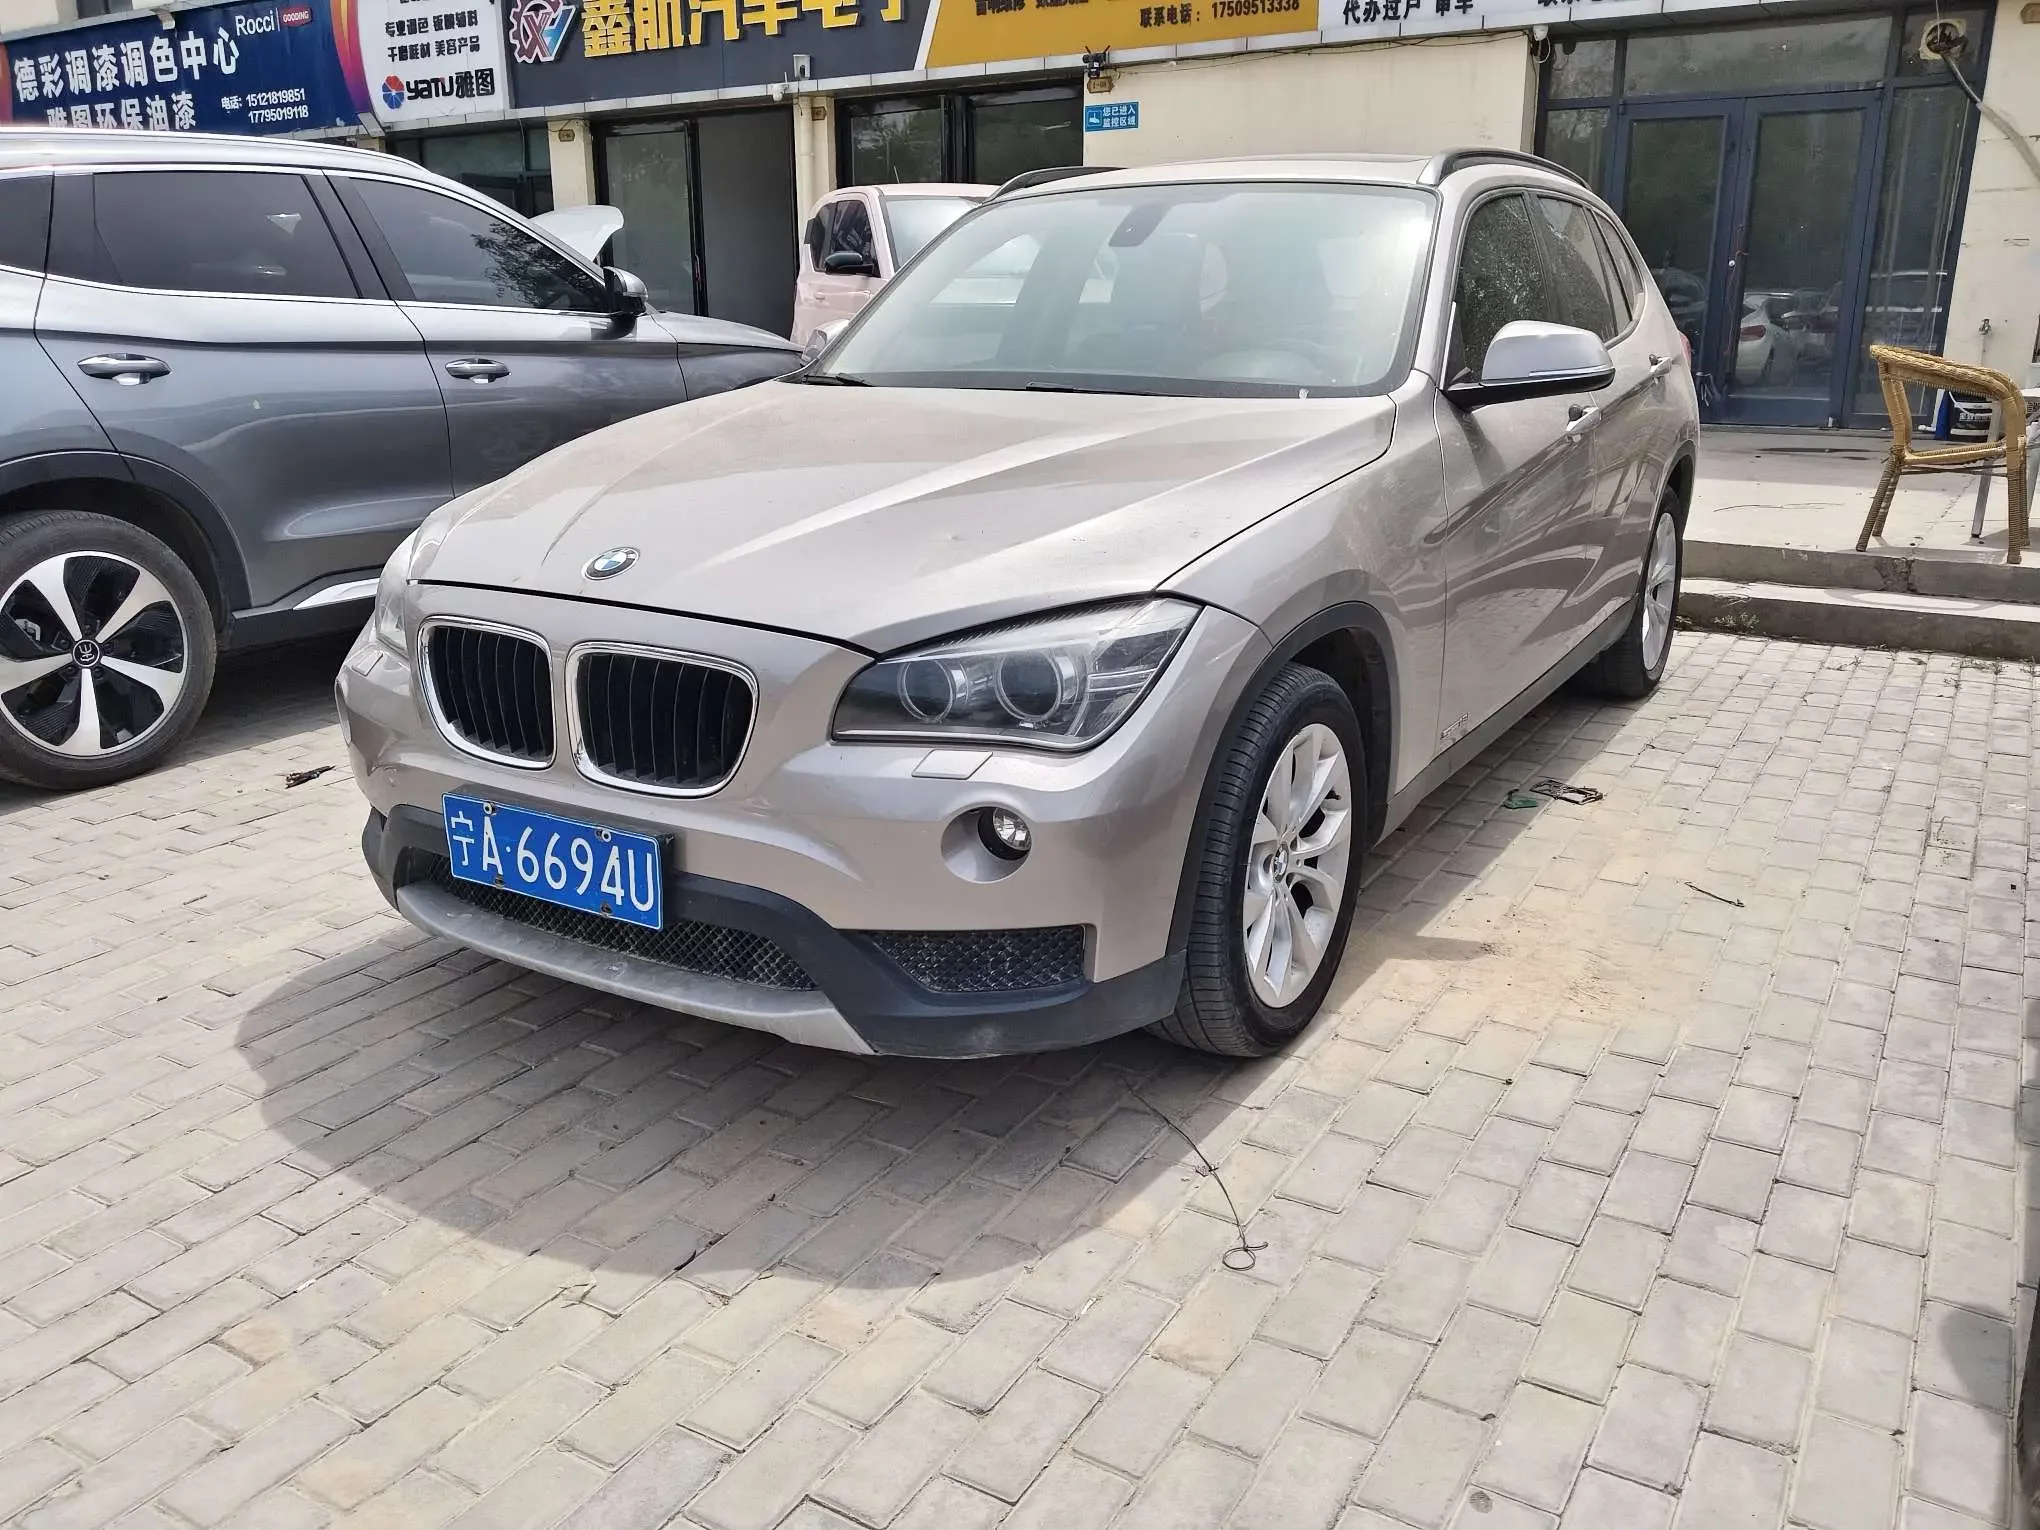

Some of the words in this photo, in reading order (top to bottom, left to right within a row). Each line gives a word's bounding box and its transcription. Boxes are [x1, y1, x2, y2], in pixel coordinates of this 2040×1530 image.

[235, 9, 275, 36] Rocci
[1342, 0, 1421, 25] 代办过户
[435, 35, 480, 56] 美容产品
[13, 27, 240, 103] 德彩调漆调色中心
[246, 87, 306, 107] 15121819851
[248, 104, 310, 124] 17795019118
